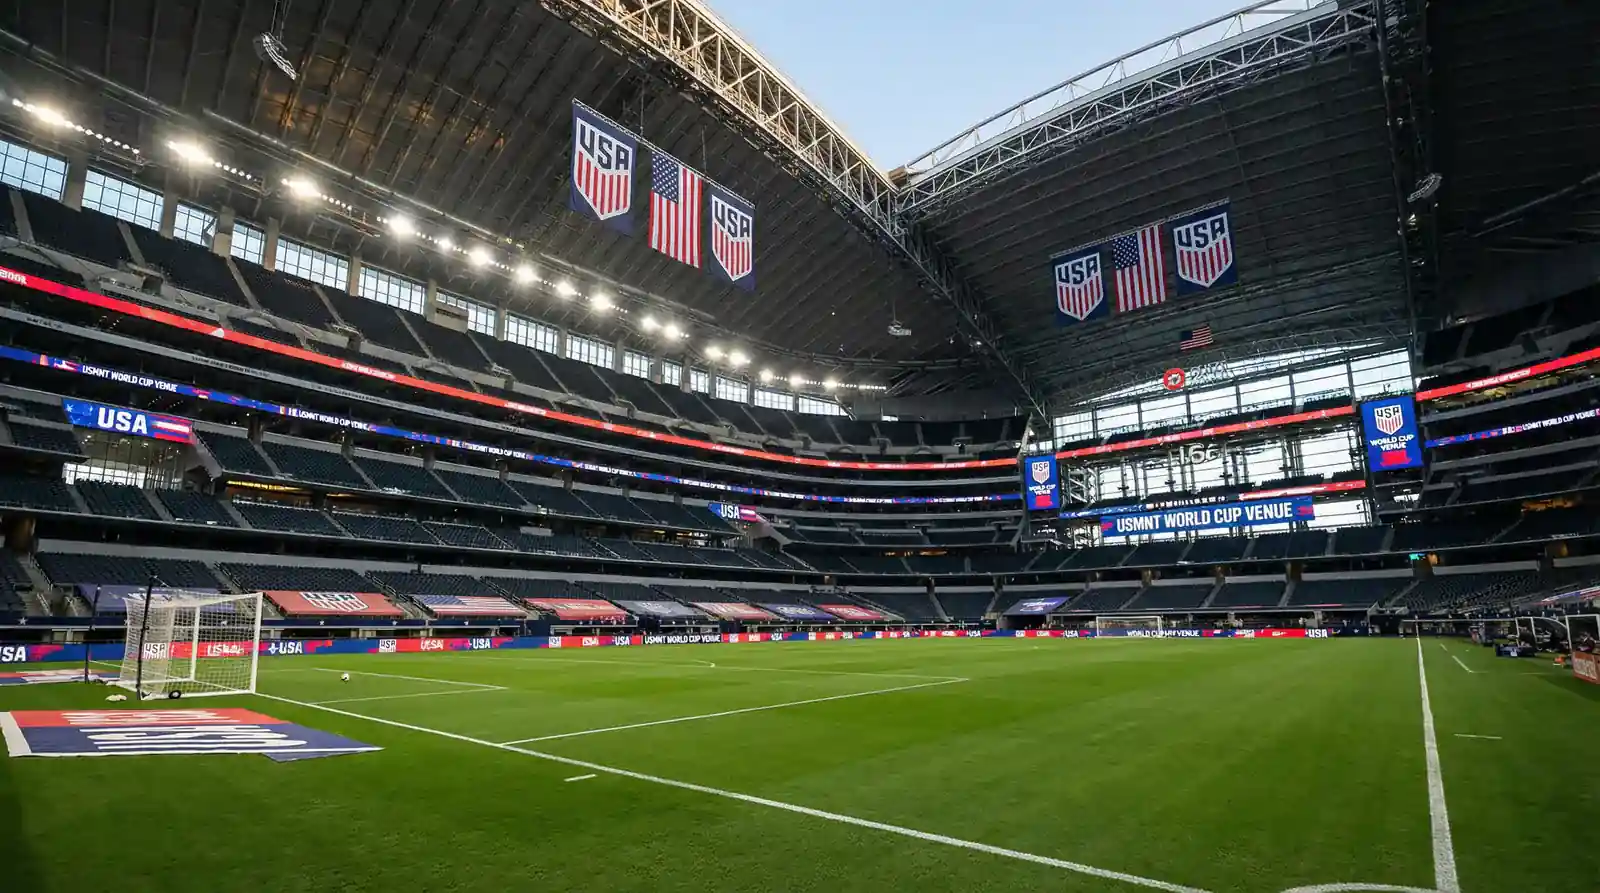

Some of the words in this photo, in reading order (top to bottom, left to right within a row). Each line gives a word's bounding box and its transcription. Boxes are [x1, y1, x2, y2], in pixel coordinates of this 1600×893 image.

[579, 123, 630, 171] USA
[714, 200, 750, 238] USA
[1177, 218, 1225, 250] USA
[1057, 256, 1098, 284] USA
[82, 365, 110, 378] USMNT
[111, 371, 138, 384] WORLD
[138, 378, 154, 388] CUP
[98, 407, 148, 434] USA
[1376, 407, 1400, 418] USA
[1370, 436, 1397, 447] WORLD
[1398, 434, 1415, 443] CUP
[720, 504, 740, 520] USA
[1116, 514, 1161, 533] USMNT
[1164, 510, 1210, 529] WORLD
[1213, 507, 1242, 525] CUP
[1244, 502, 1293, 521] VENUE
[615, 636, 630, 646] USA
[1308, 628, 1328, 638] USA
[278, 641, 303, 654] USA
[472, 638, 491, 650] USA
[0, 646, 26, 662] SA
